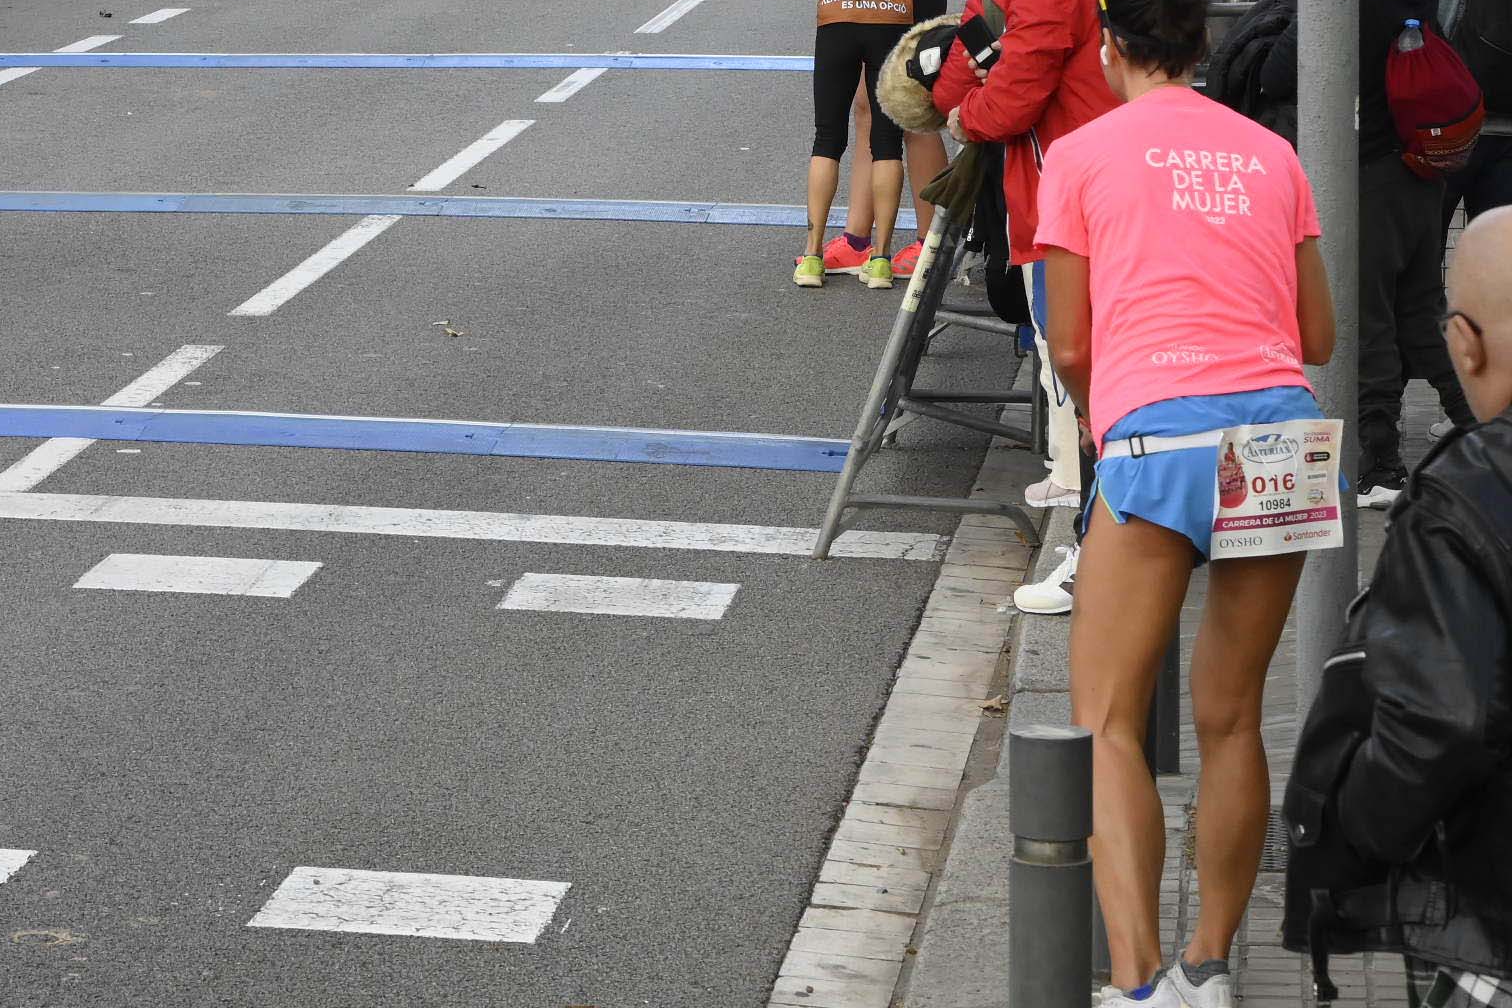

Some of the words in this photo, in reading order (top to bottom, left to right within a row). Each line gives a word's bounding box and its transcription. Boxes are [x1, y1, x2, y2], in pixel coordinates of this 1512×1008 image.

[841, 1, 854, 9] ES
[855, 0, 877, 9] UNA
[1145, 147, 1267, 175] CARRERA
[1172, 170, 1205, 190] DE
[1213, 172, 1246, 193] LA
[1172, 190, 1253, 217] MUJER
[1303, 435, 1331, 444] SUMA
[1251, 472, 1296, 494] 016
[1259, 498, 1292, 511] 10984
[1222, 518, 1262, 529] CARRERA
[1262, 517, 1273, 525] DE
[1274, 515, 1284, 523] LA
[1285, 512, 1308, 523] MUJER
[1219, 535, 1263, 549] OYSHO
[1292, 529, 1331, 541] Santander
